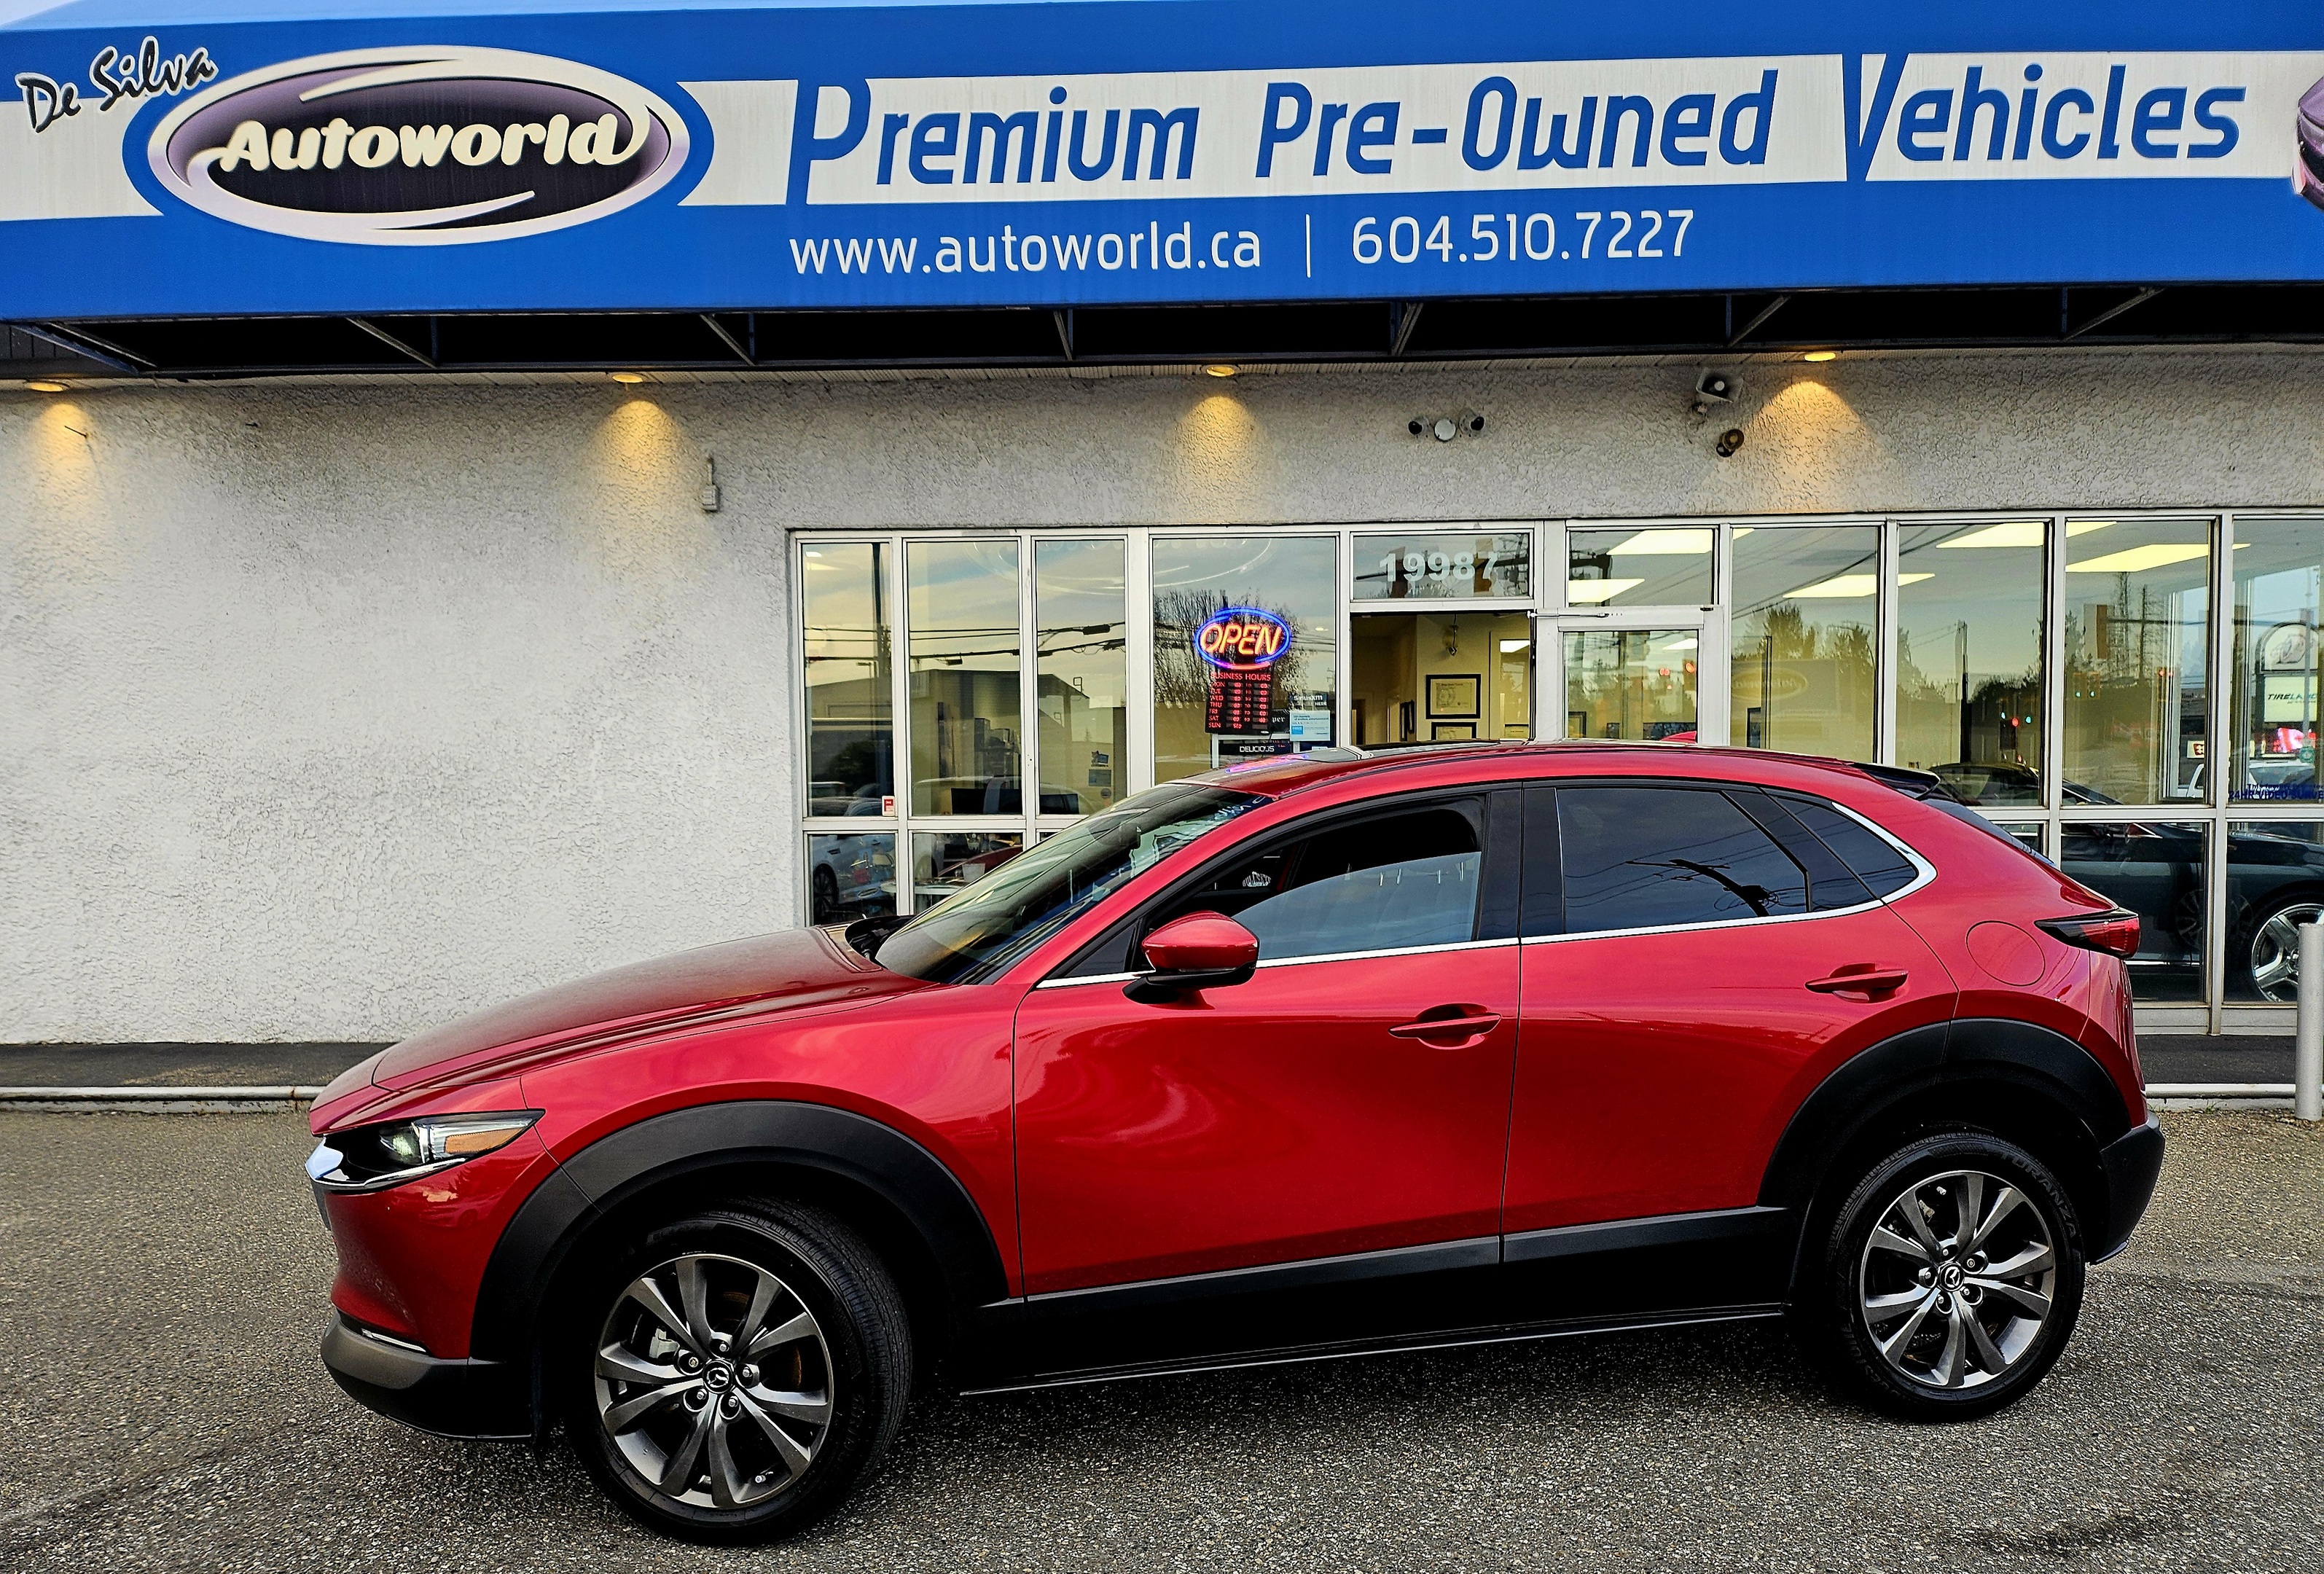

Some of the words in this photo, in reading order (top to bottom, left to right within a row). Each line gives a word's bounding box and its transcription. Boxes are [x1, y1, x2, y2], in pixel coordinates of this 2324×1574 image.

[16, 74, 82, 133] De
[90, 37, 217, 111] Silva
[219, 114, 627, 172] Autoworld
[786, 76, 1200, 204] Premium
[1256, 69, 1778, 178] Pre-Owned
[1842, 54, 2245, 181] Vehicles
[790, 221, 1260, 274] www.autoworld.ca
[1353, 209, 1694, 264] 604.510.7227
[1380, 551, 1498, 582] 19987
[1200, 622, 1283, 655] OPEN
[1210, 672, 1243, 681] BUSINESS
[1245, 673, 1271, 681] HOURS
[2258, 790, 2288, 800] VIDEO
